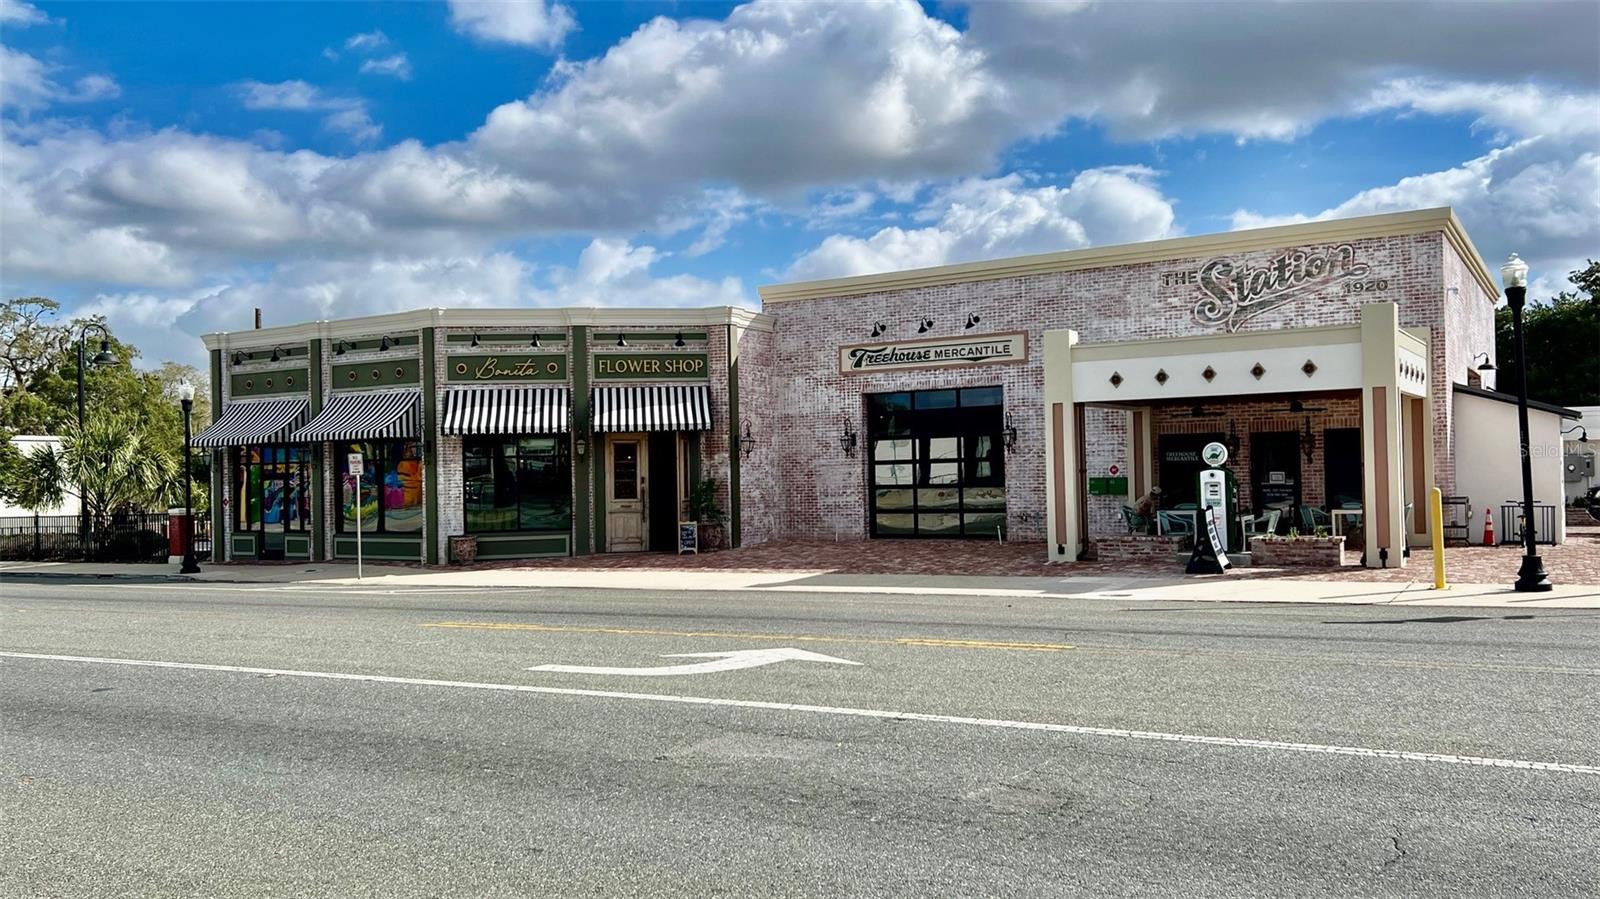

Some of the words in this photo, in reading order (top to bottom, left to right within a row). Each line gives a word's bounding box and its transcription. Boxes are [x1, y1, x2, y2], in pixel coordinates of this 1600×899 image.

[1161, 271, 1198, 287] THE
[1194, 244, 1370, 331] Station
[1344, 280, 1388, 294] 1920
[934, 345, 1010, 359] MERCANTILE
[475, 357, 540, 379] Bonita
[599, 360, 659, 373] FLOWER
[666, 359, 703, 372] SHOP
